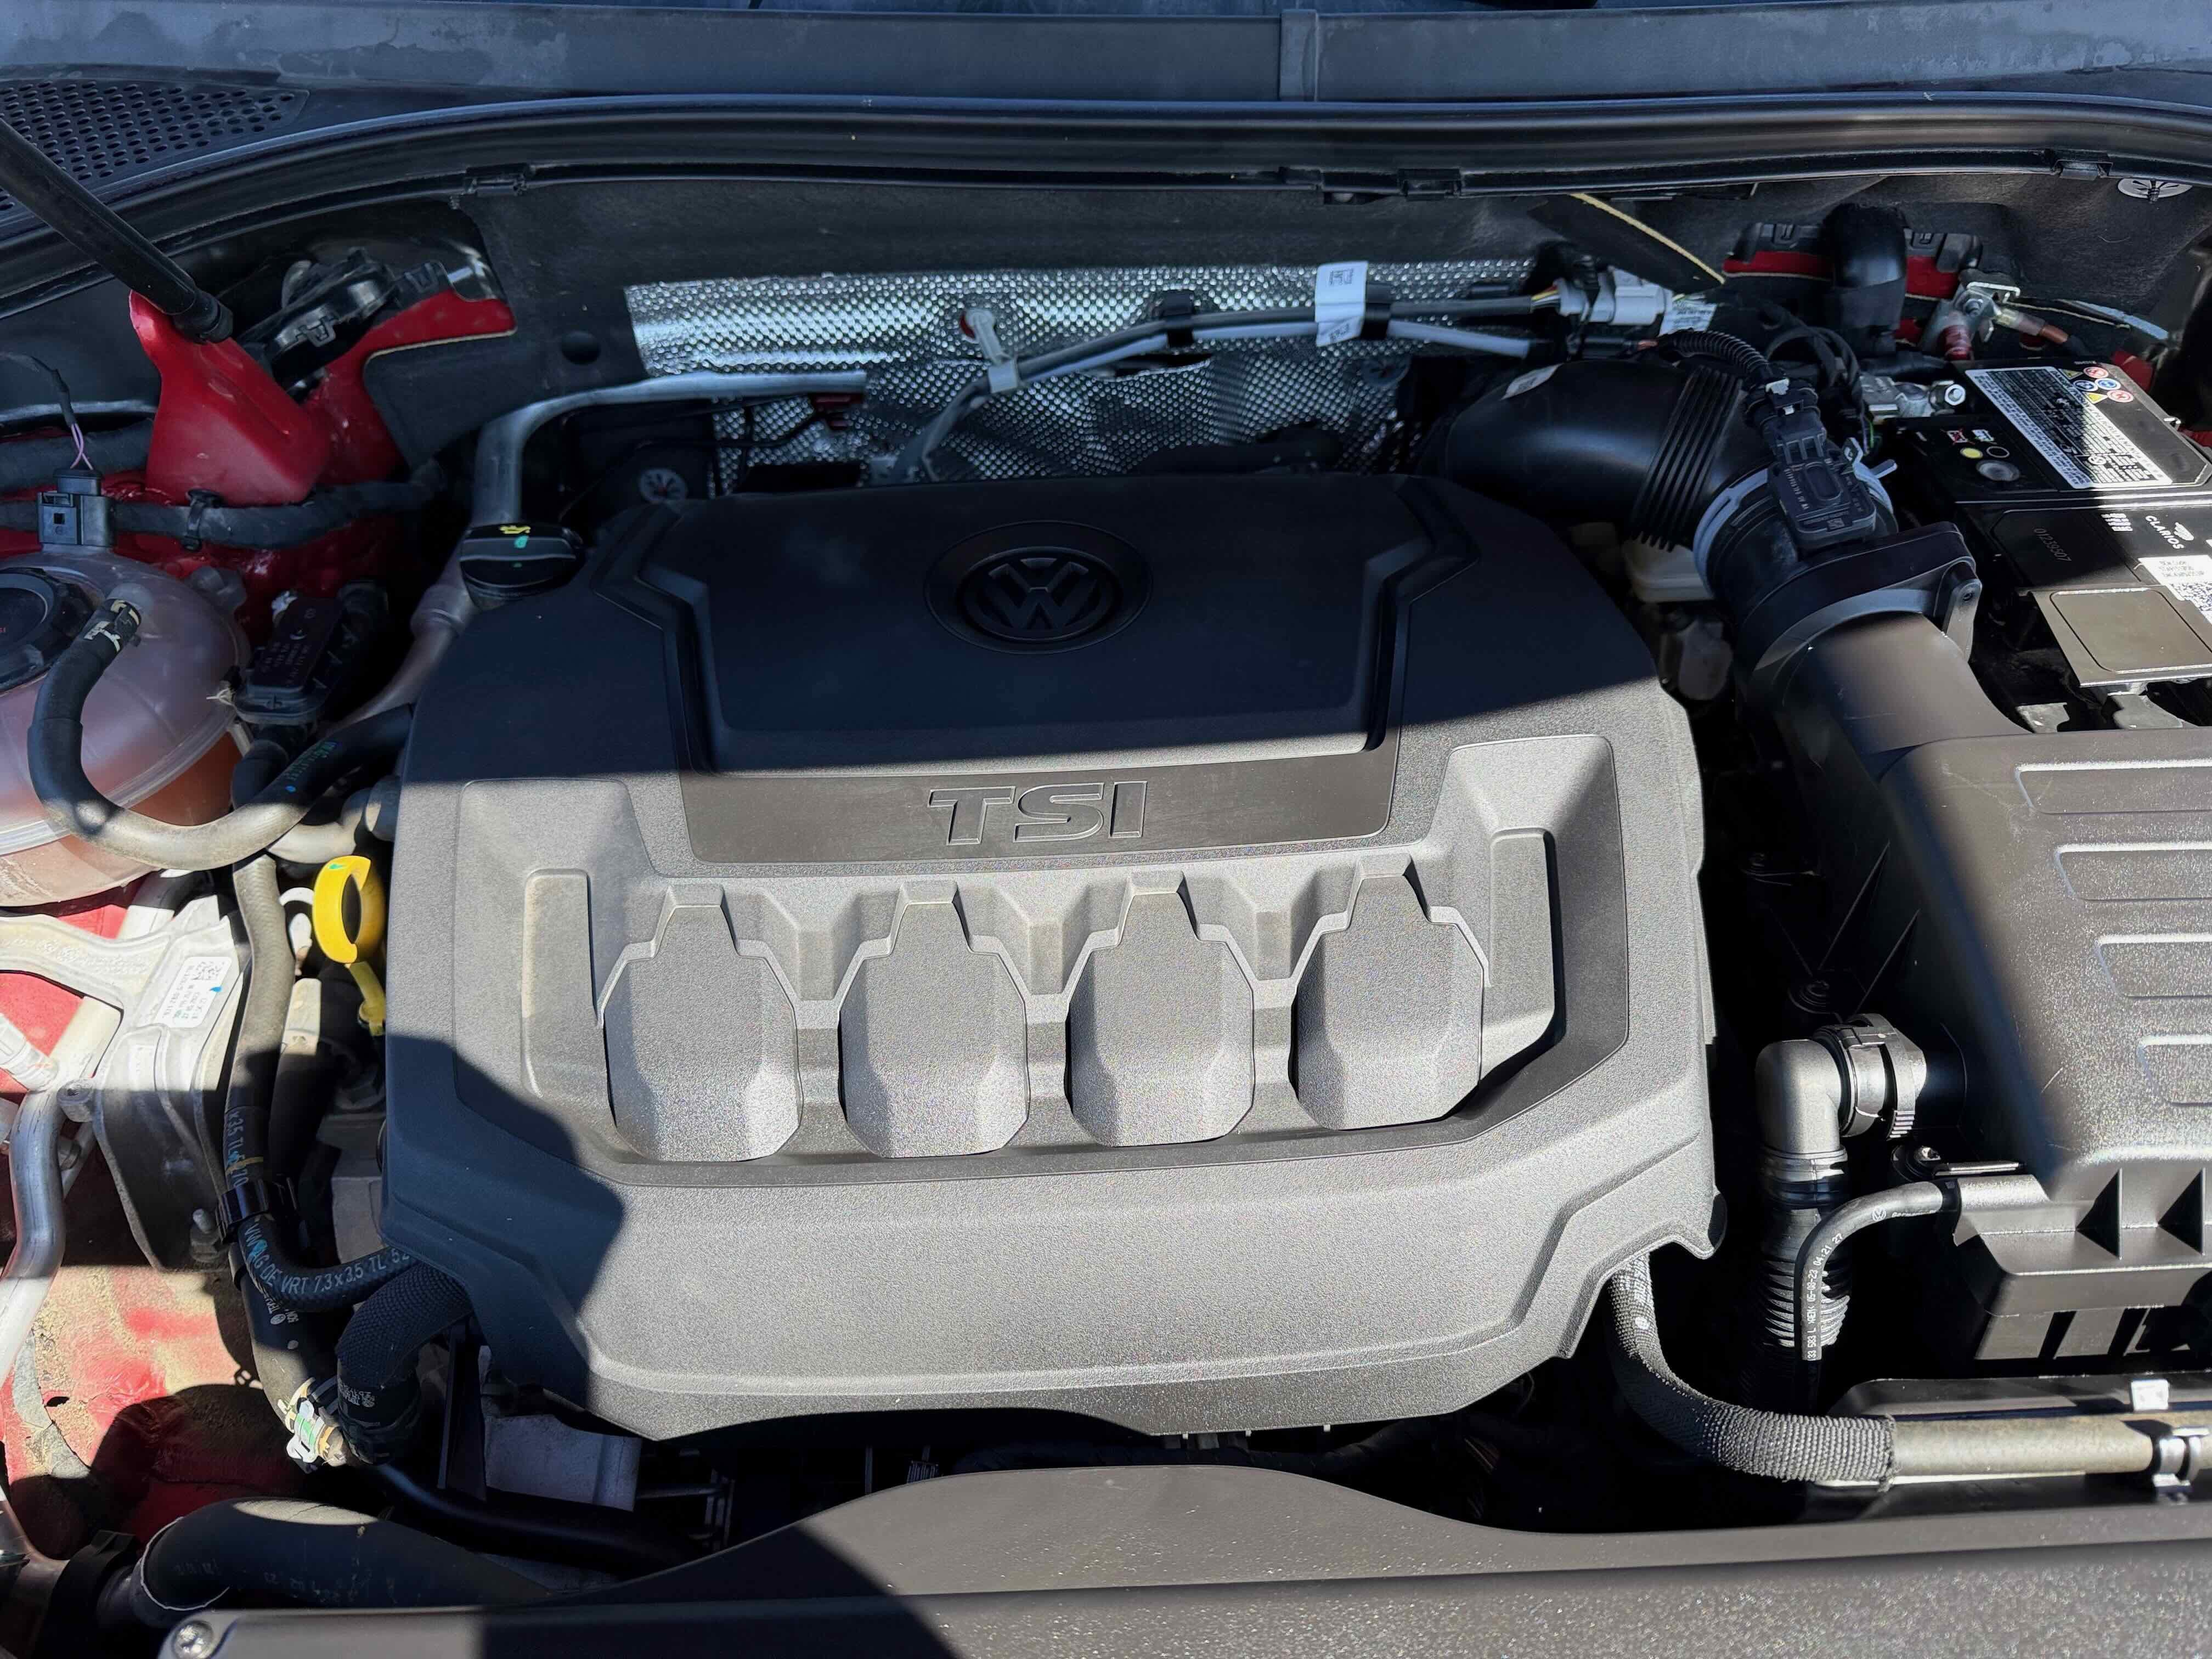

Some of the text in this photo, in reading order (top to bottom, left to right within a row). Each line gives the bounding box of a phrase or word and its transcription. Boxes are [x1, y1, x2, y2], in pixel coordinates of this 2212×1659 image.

[2145, 515, 2185, 549] CLARIOS
[927, 781, 1148, 845] TSI
[259, 1263, 283, 1287] DE
[280, 1274, 308, 1295] VRT
[368, 1254, 387, 1273] TL
[1807, 1335, 1817, 1348] 583
